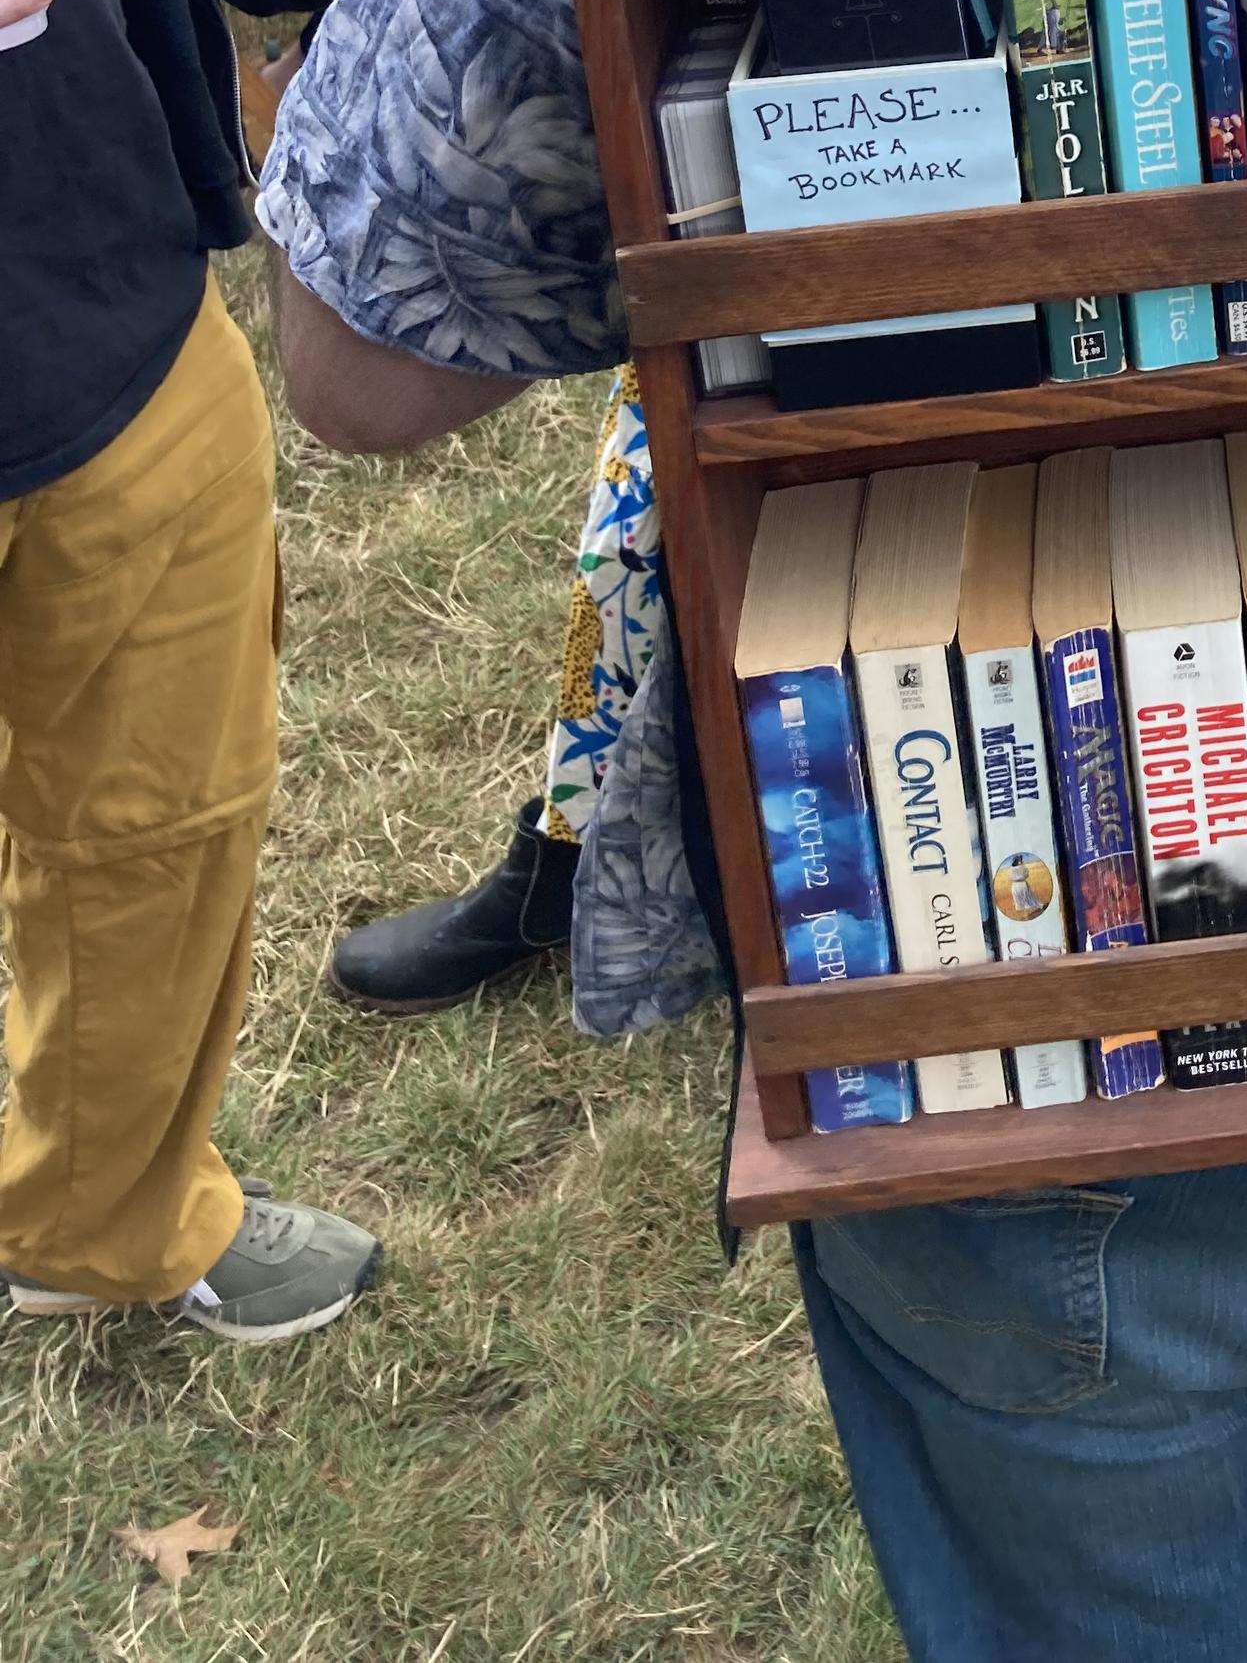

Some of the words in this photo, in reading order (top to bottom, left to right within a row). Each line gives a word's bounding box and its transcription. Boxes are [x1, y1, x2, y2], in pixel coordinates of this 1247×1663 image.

[818, 140, 879, 165] TAKE
[890, 138, 907, 155] A
[1131, 82, 1182, 185] STEEL
[788, 158, 966, 200] BOOKMARK
[1167, 288, 1195, 342] Ties
[1012, 743, 1039, 801] LARRY
[1072, 724, 1124, 850] MAGIC
[1079, 783, 1090, 801] The
[1137, 702, 1200, 862] CRICHTON
[792, 788, 830, 890] CATCH-22
[1081, 801, 1094, 854] Gathering
[931, 893, 958, 950] CARL
[1177, 1053, 1203, 1066] NEW
[1208, 1048, 1238, 1061] YORK
